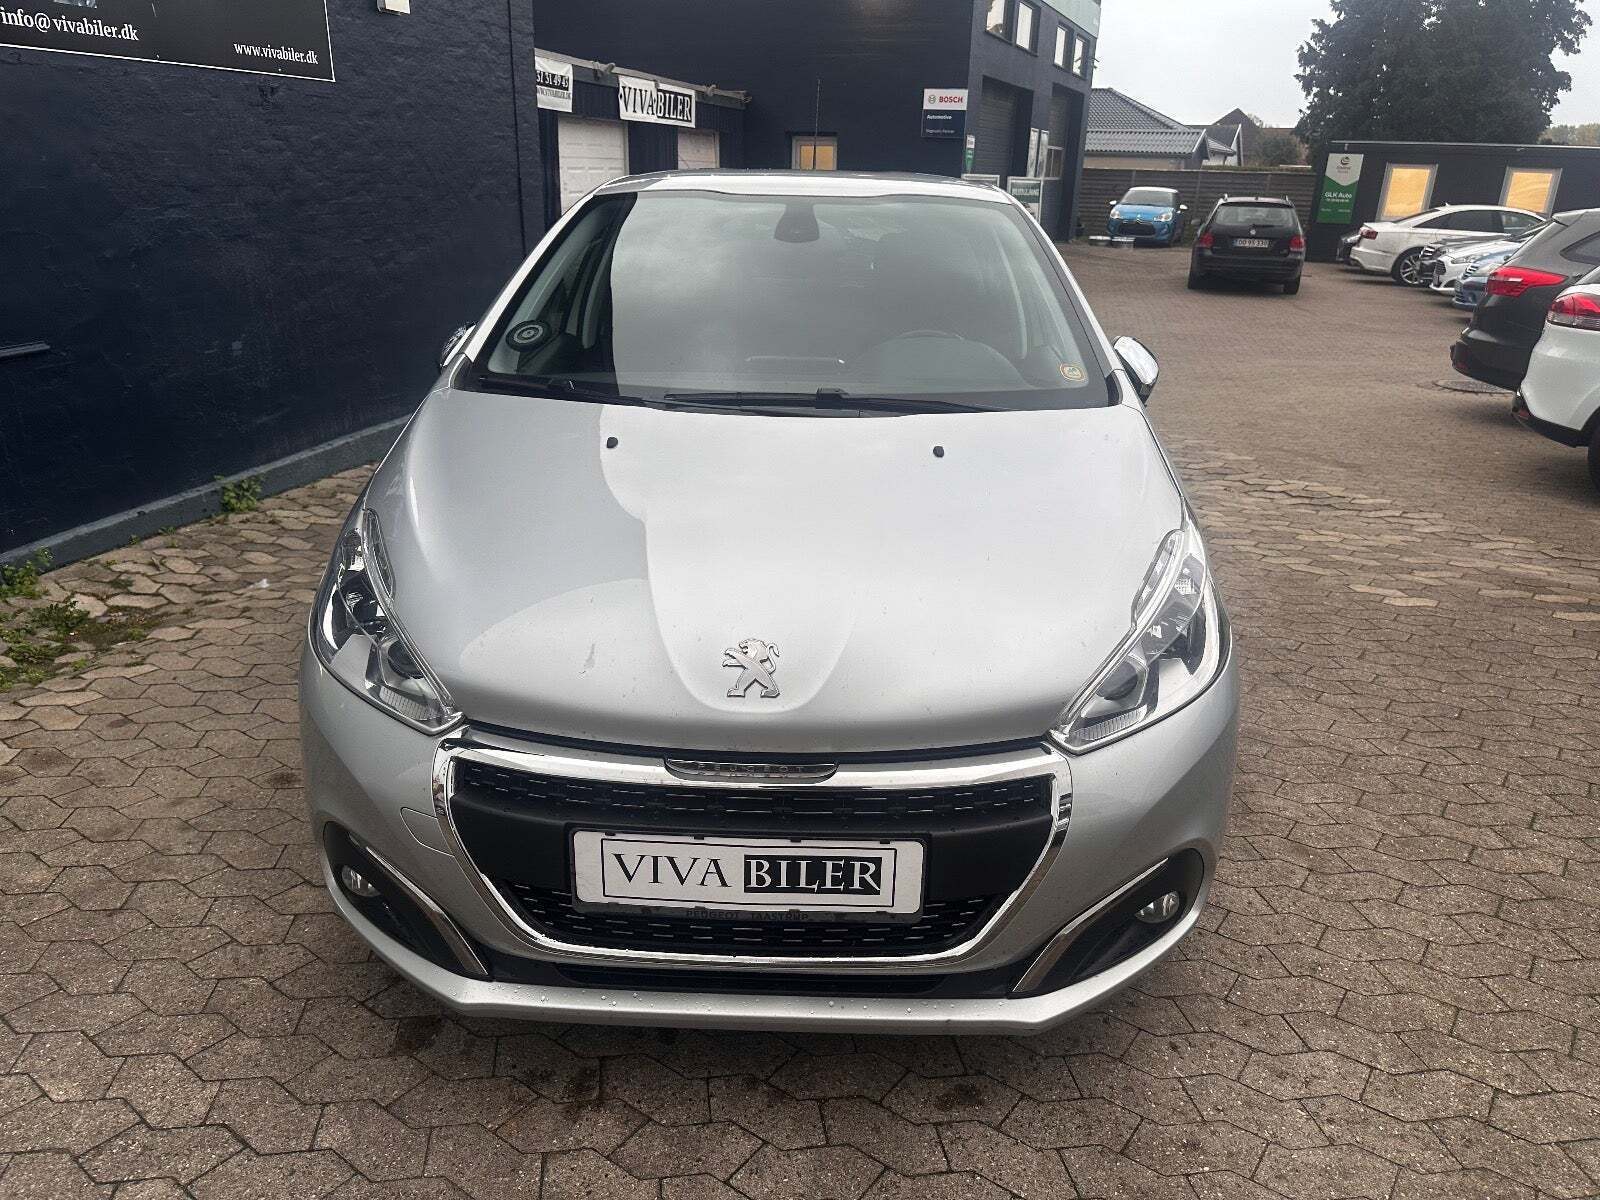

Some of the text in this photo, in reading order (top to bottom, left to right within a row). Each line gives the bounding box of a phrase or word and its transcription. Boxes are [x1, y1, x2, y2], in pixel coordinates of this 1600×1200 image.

[233, 41, 319, 65] www.vivabiler.dk
[621, 85, 692, 122] VIVA BILER
[1338, 191, 1352, 199] Auto
[612, 852, 881, 893] VIVA BILER
[686, 911, 741, 920] PEUGEOT
